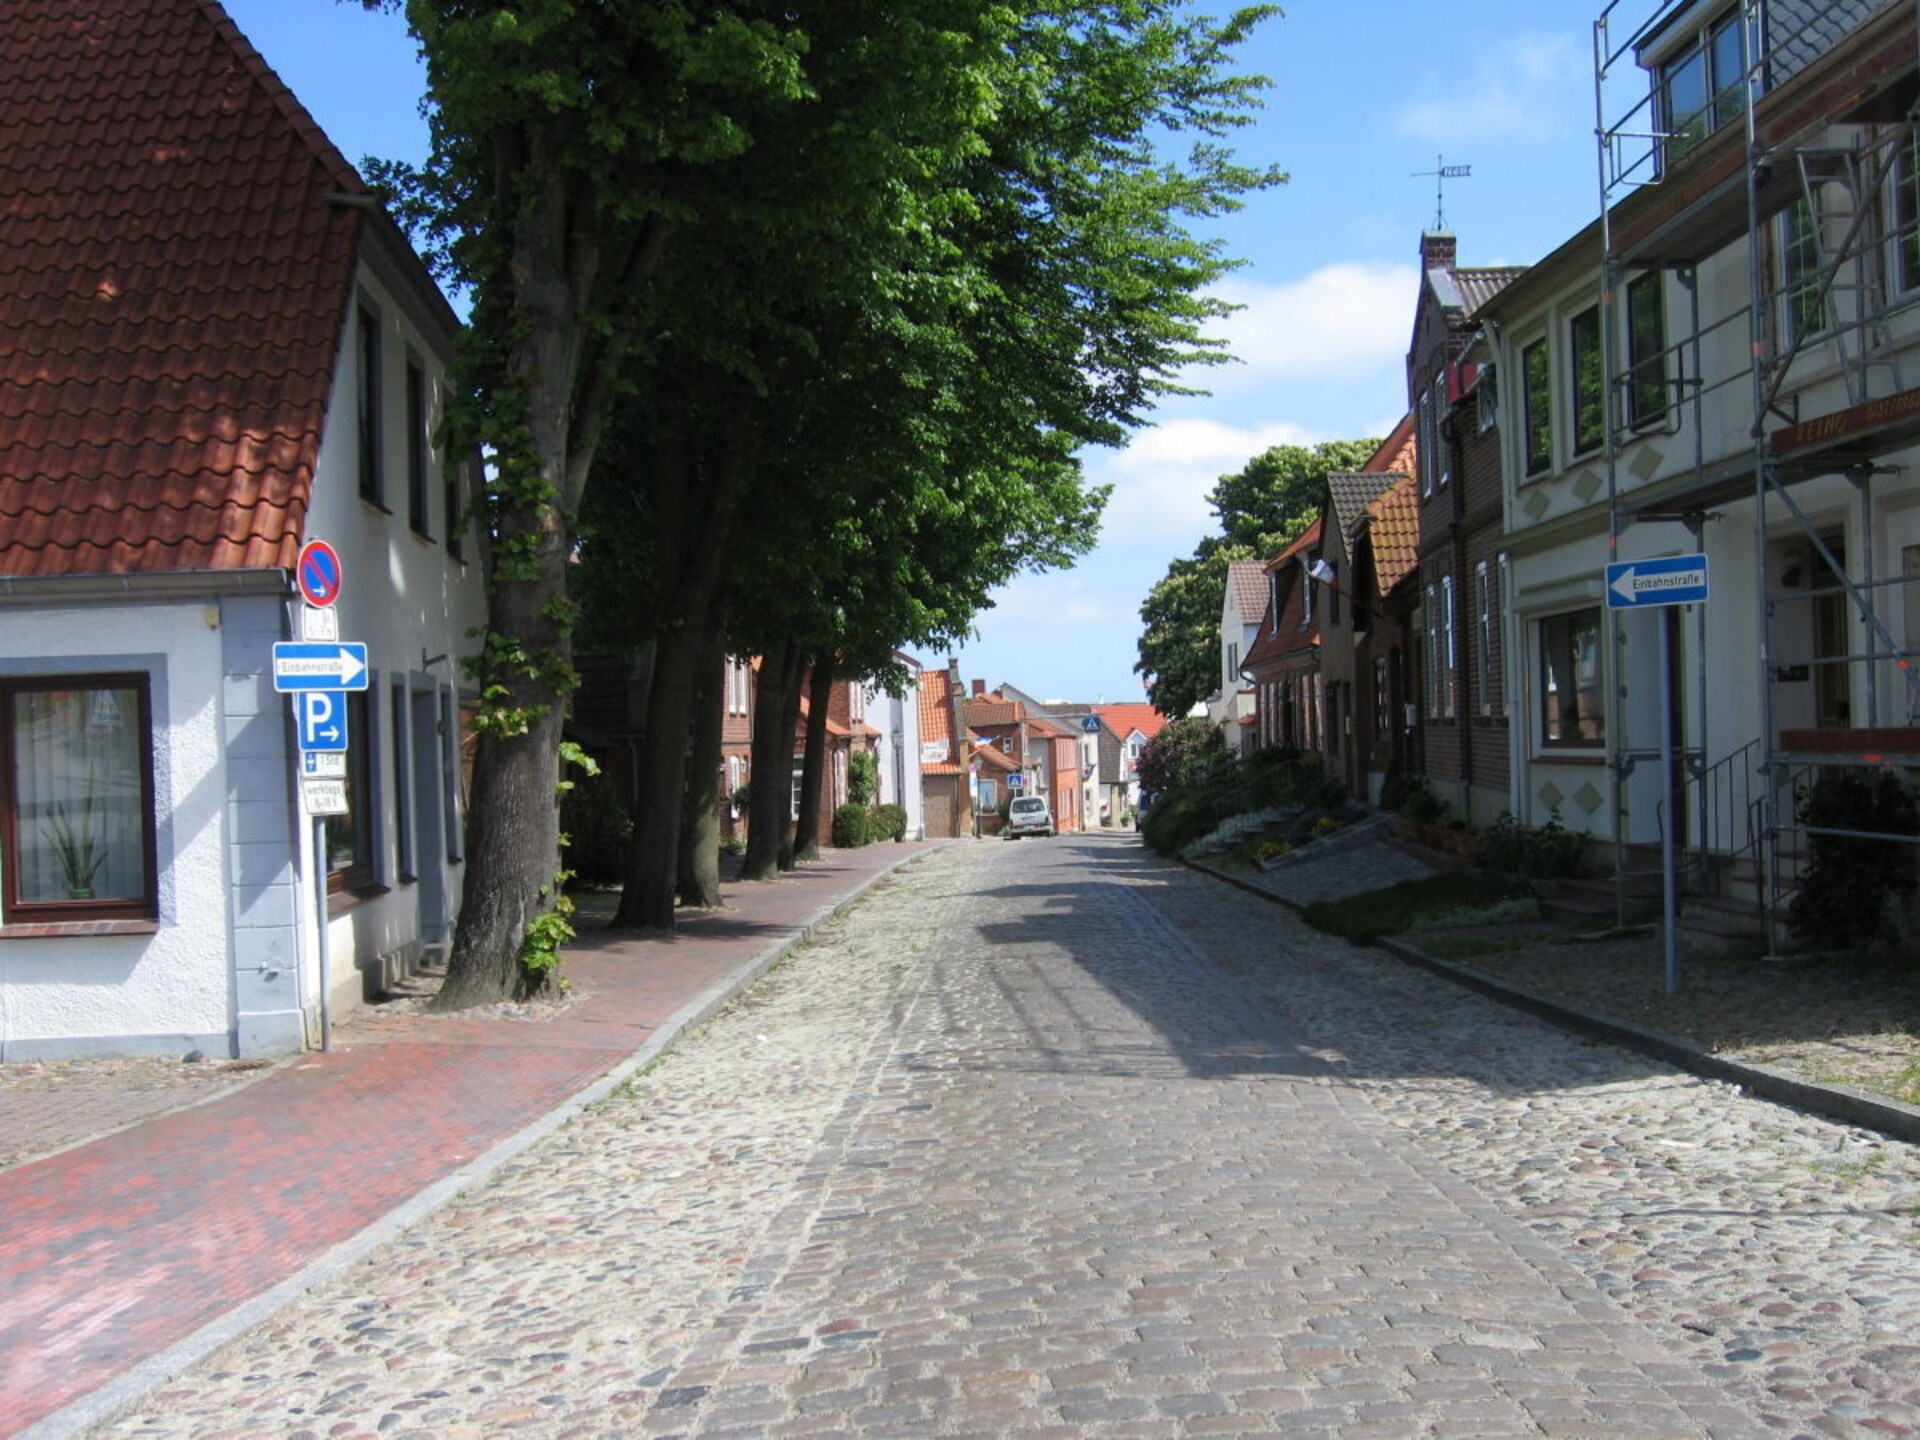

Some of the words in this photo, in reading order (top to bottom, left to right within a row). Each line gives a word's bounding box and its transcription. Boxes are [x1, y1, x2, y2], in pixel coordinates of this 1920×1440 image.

[1633, 574, 1700, 590] Einbahnstraße
[281, 661, 343, 673] Einbahnstraße
[306, 693, 332, 743] P
